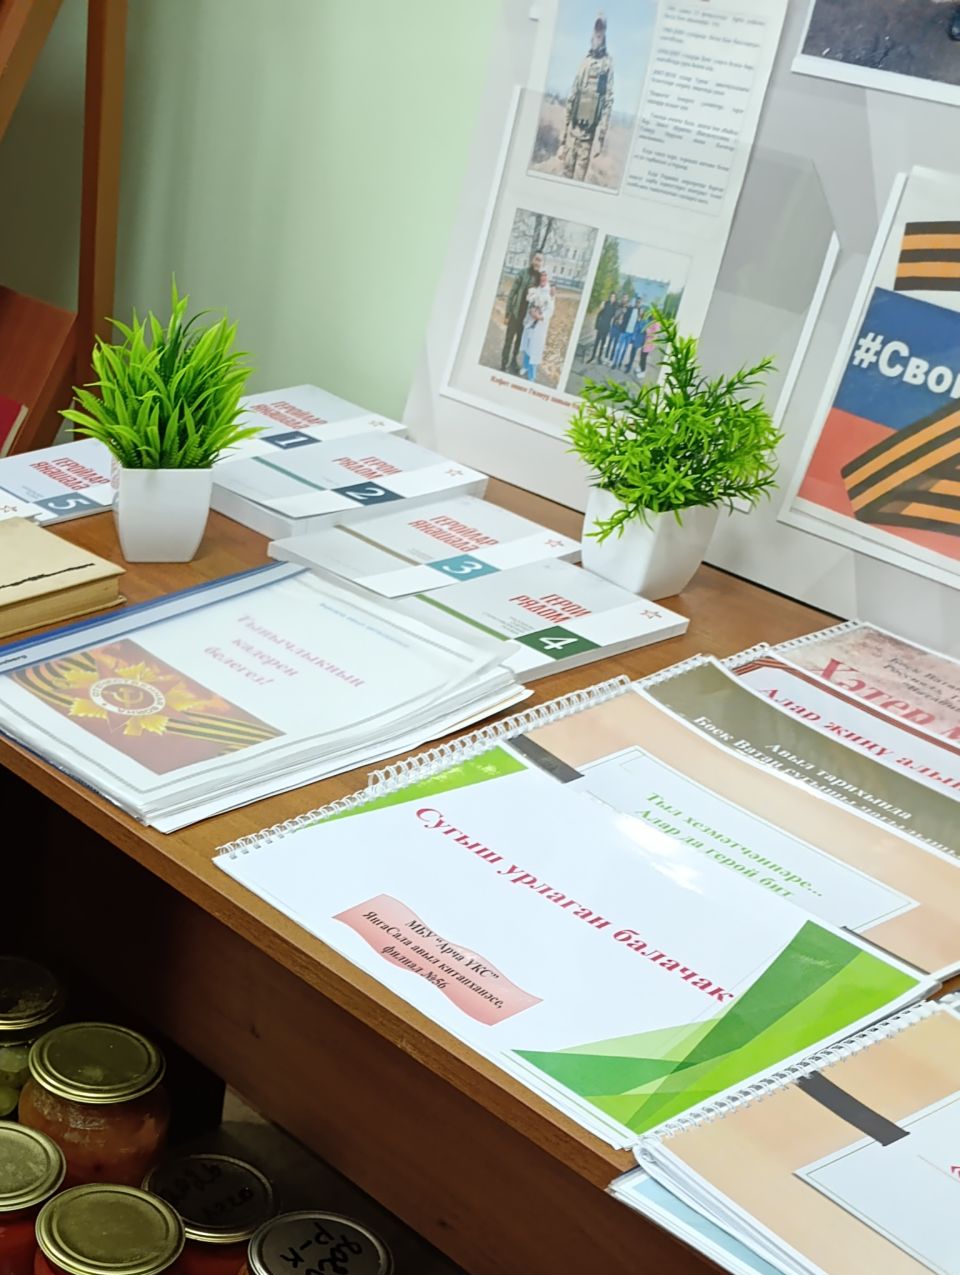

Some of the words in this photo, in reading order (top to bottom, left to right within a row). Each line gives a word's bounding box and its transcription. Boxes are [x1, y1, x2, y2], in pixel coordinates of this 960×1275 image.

[344, 487, 386, 500] 2
[48, 496, 89, 512] 5
[442, 561, 483, 575] 3
[539, 636, 579, 651] 4
[757, 688, 821, 722] Алар
[646, 792, 682, 817] Тыл
[636, 809, 682, 837] Алар
[681, 836, 704, 850] да
[705, 848, 758, 879] герой
[415, 806, 504, 866] Сугыш
[497, 858, 614, 931] урлаган
[611, 928, 735, 1003] балачак
